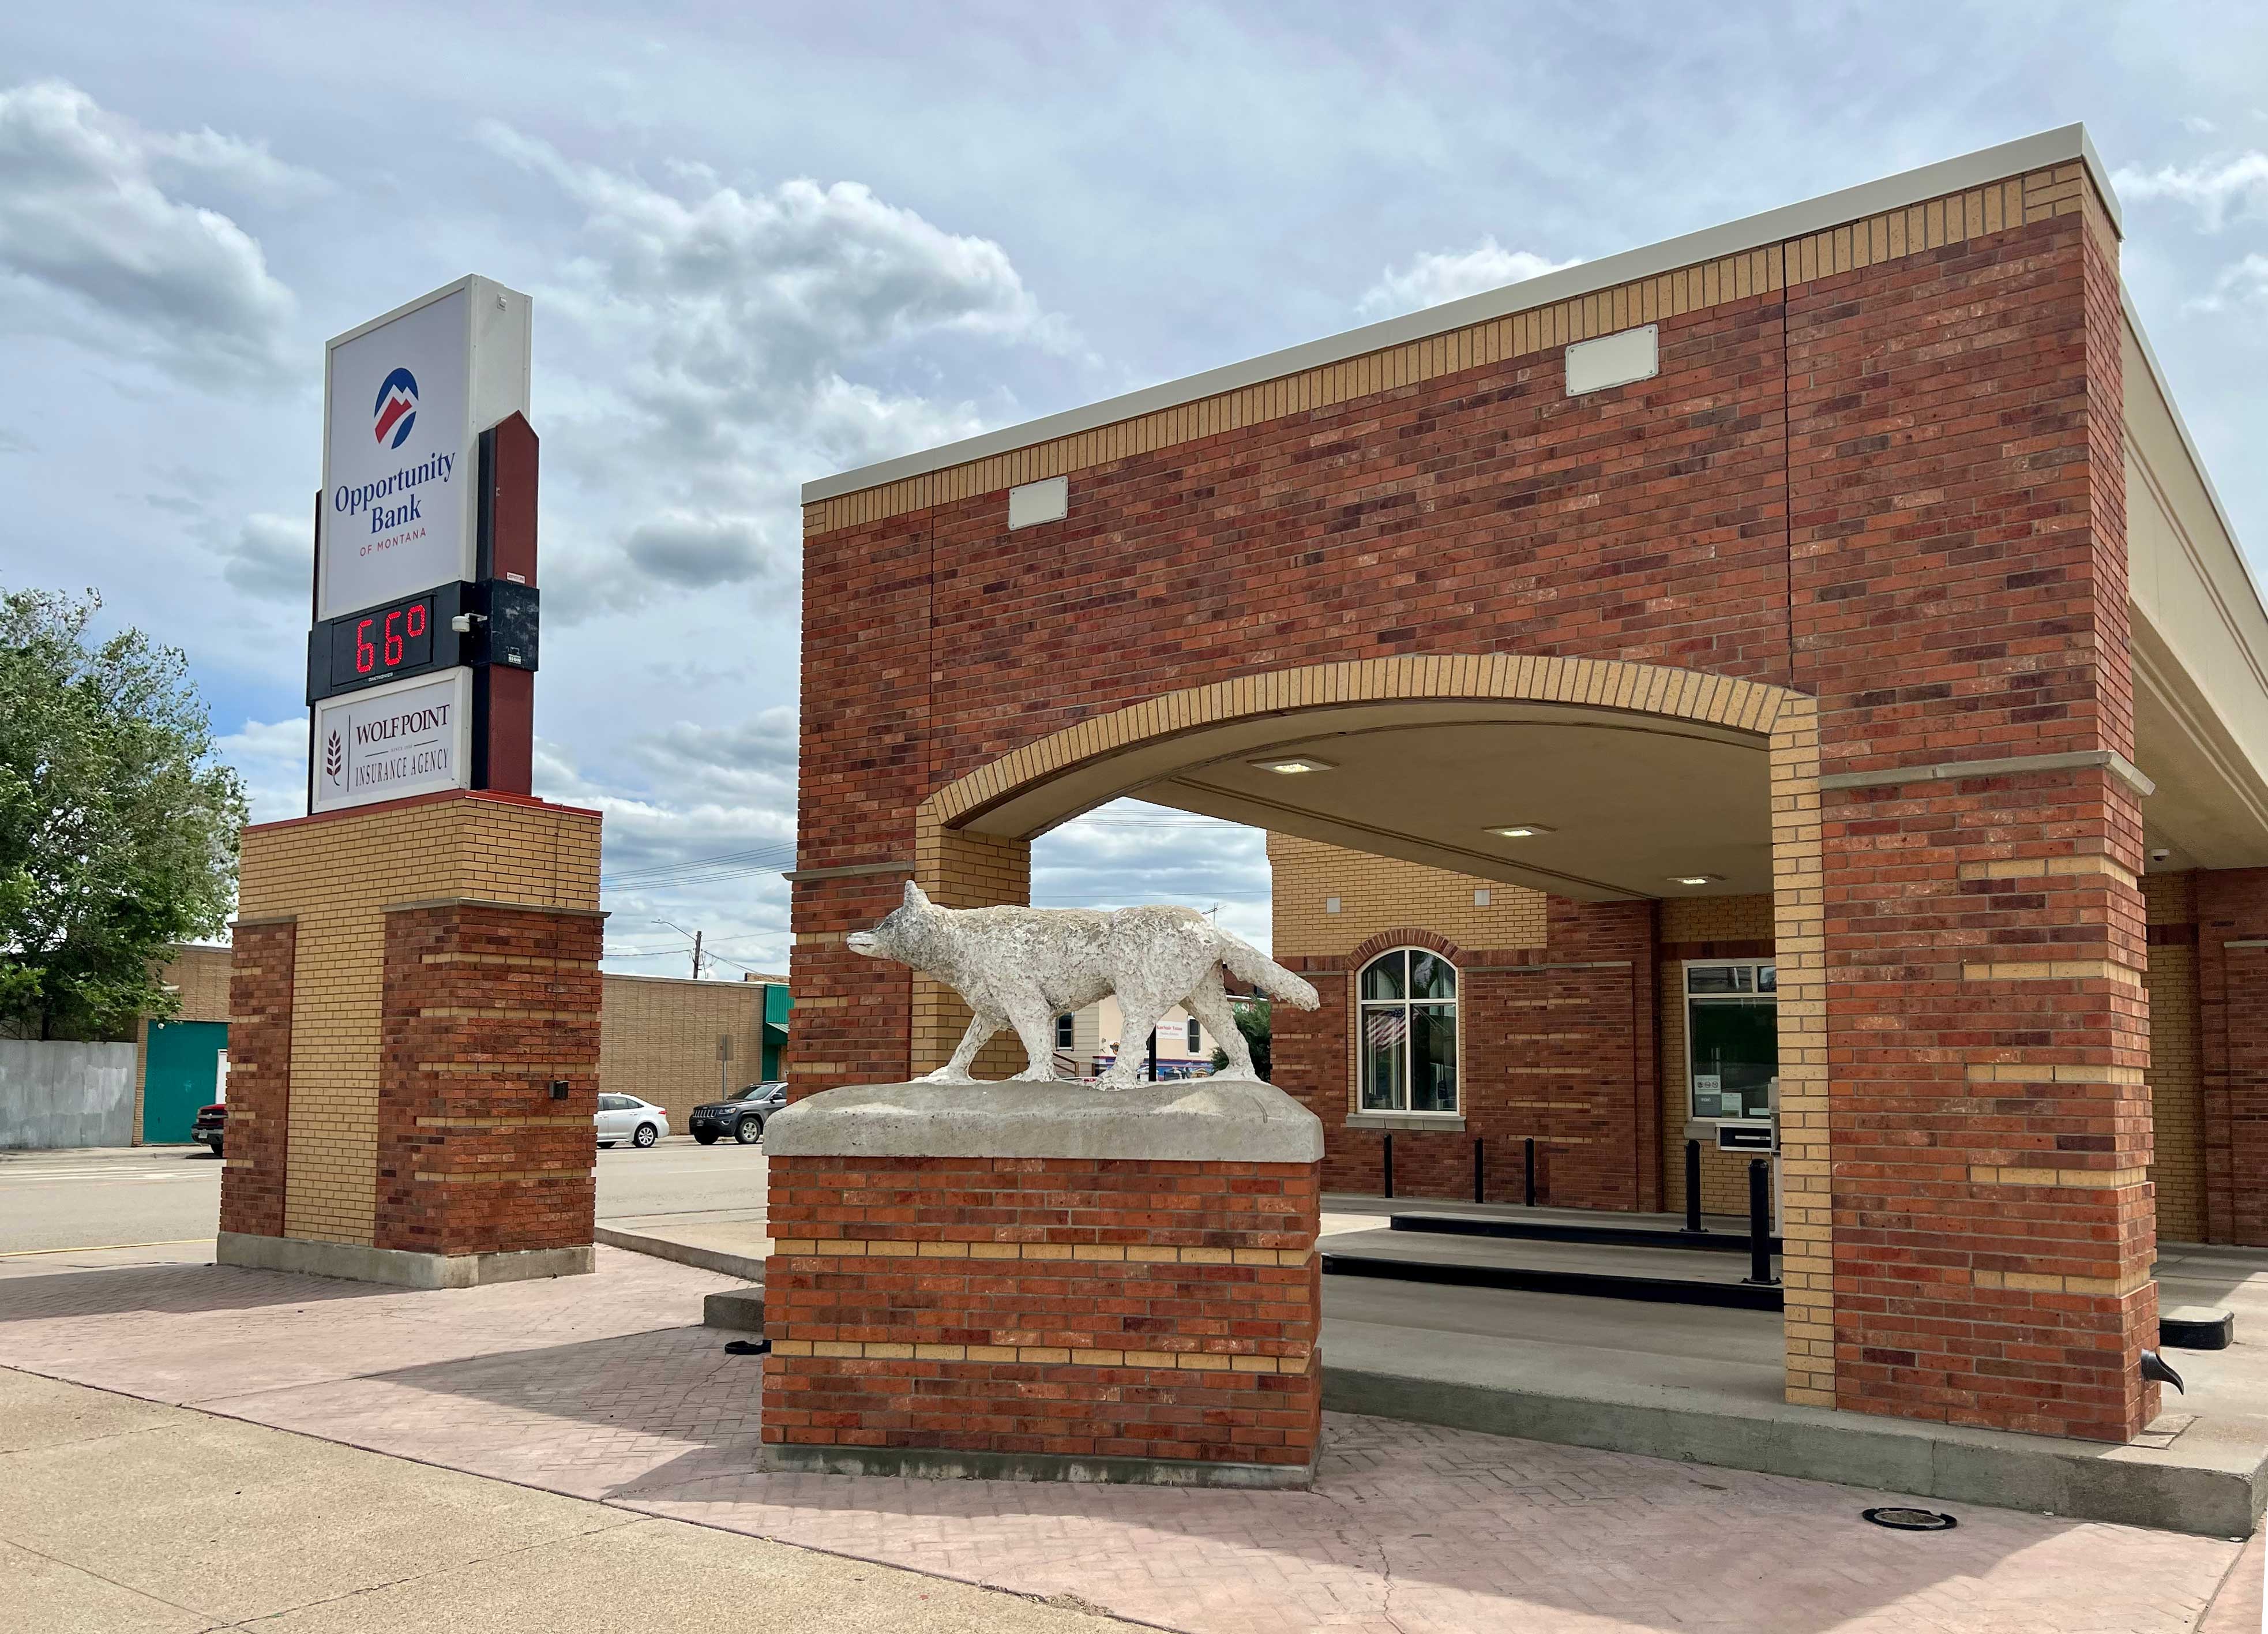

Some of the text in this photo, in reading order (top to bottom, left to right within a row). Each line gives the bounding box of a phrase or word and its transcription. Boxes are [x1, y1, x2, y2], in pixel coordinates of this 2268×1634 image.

[335, 452, 456, 516] Opportunity
[371, 494, 422, 534] Bank
[360, 527, 426, 557] OF MONTANA
[356, 748, 448, 787] INSURANCE AGENCY
